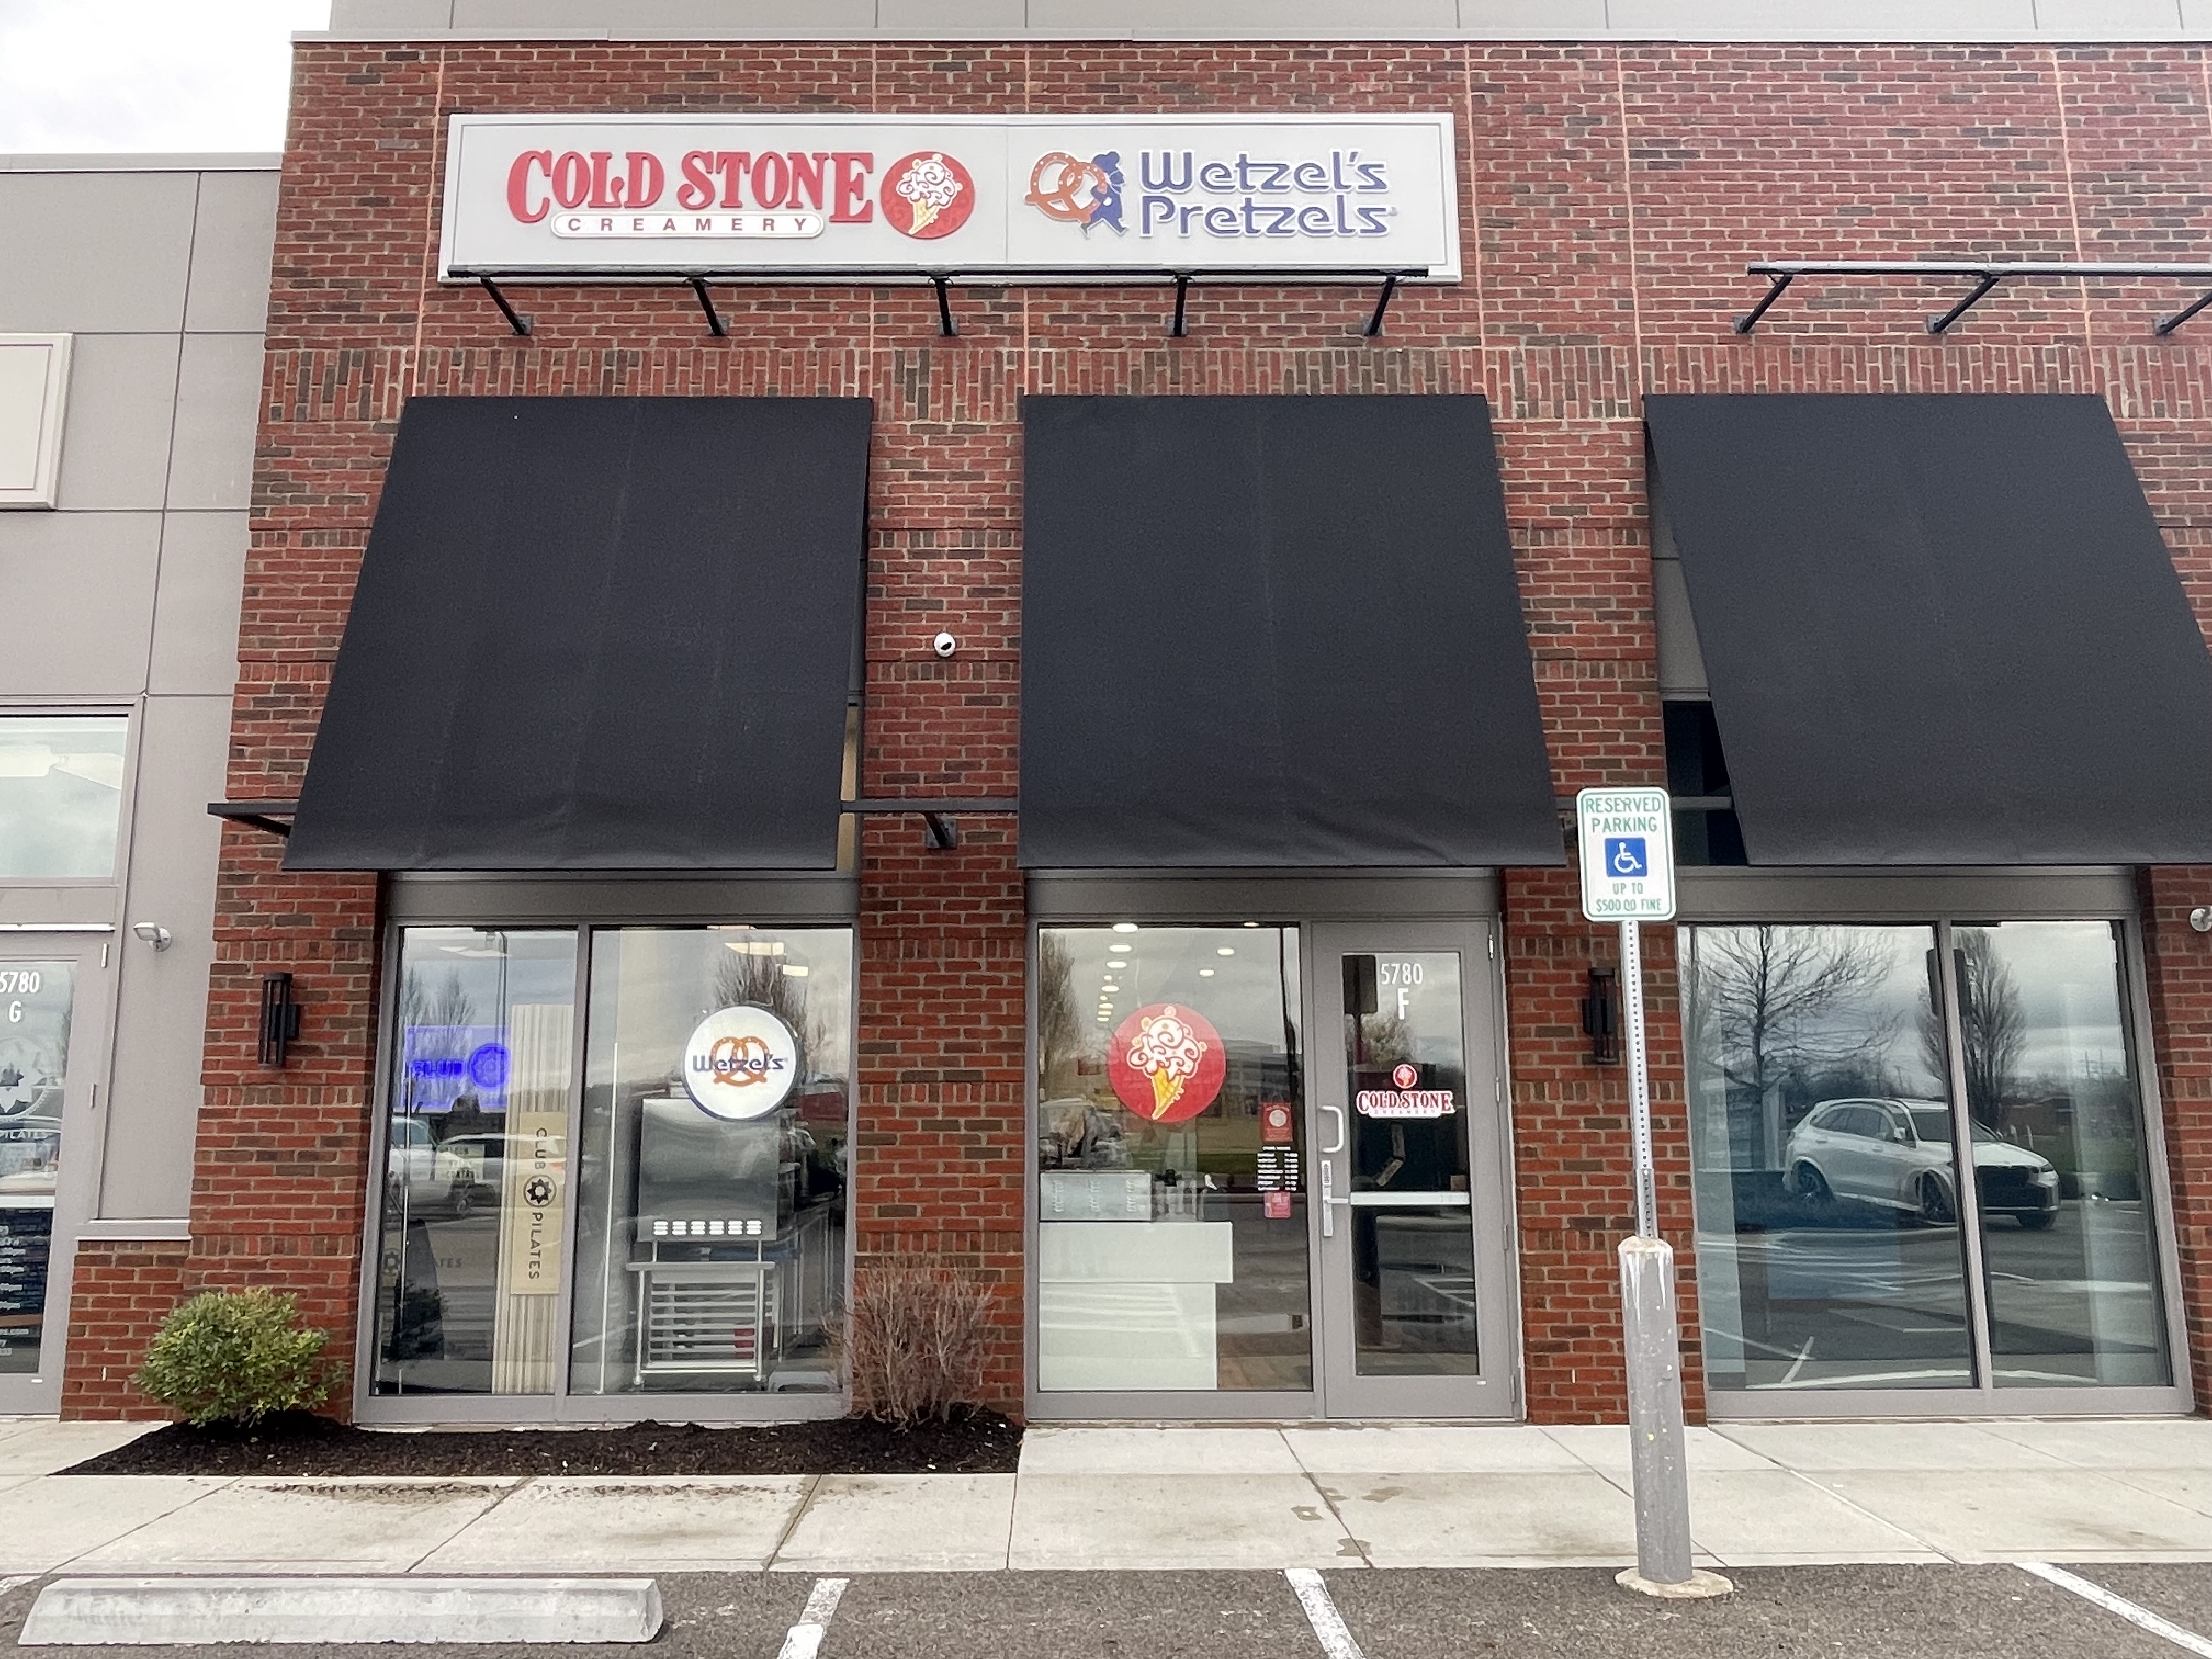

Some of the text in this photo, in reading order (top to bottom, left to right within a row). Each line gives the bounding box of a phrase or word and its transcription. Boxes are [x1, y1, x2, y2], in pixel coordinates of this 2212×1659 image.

[1139, 149, 1389, 192] Wetzel's
[507, 150, 874, 223] COLD STONE
[568, 217, 809, 232] CREAMERY
[1140, 194, 1389, 236] Pretzels
[1585, 797, 1661, 813] RESERVED
[1591, 816, 1657, 833] PARKING
[1612, 882, 1644, 895] UP TO
[1641, 899, 1661, 911] FINE
[0, 970, 40, 994] 5780
[1380, 963, 1423, 984] 5780
[9, 1000, 22, 1023] G
[1398, 988, 1410, 1020] F
[692, 1053, 785, 1072] Wetzel's
[1358, 1092, 1451, 1111] COLD STONE
[528, 1127, 547, 1280] CLUB PILATES
